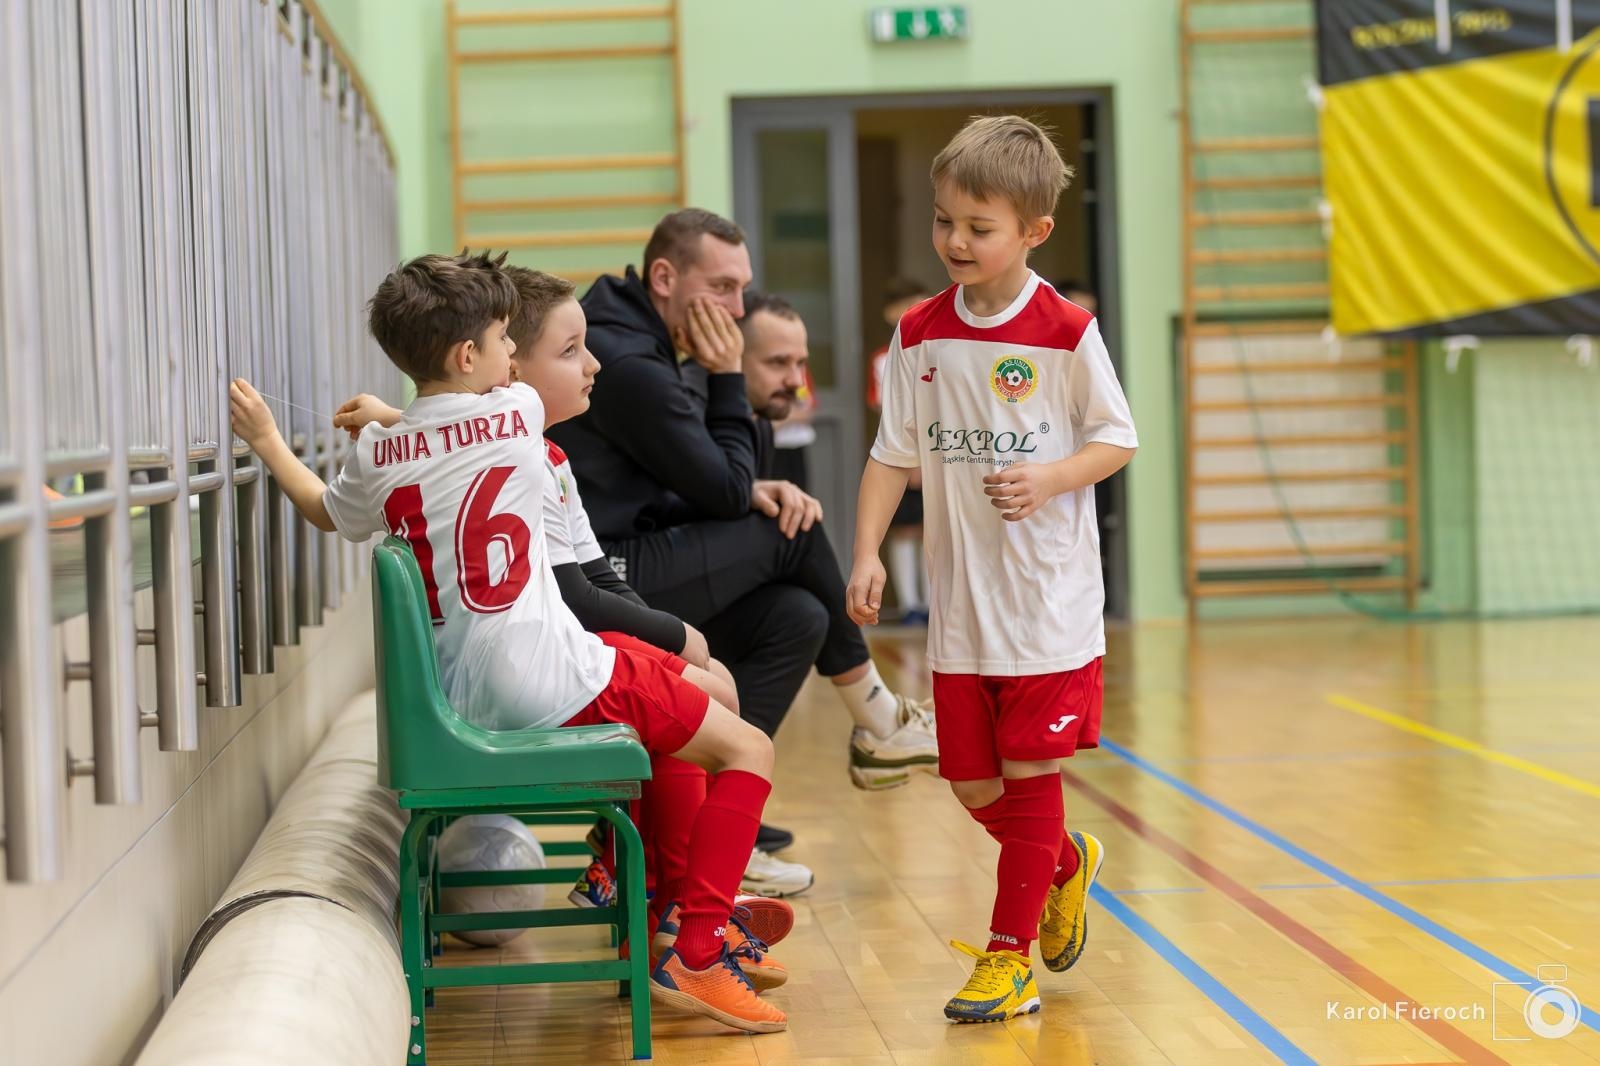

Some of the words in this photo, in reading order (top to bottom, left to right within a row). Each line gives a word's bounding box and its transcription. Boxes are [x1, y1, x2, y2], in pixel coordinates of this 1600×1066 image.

[373, 431, 432, 468] UNIA
[438, 409, 529, 454] TURZA
[381, 465, 531, 627] 16
